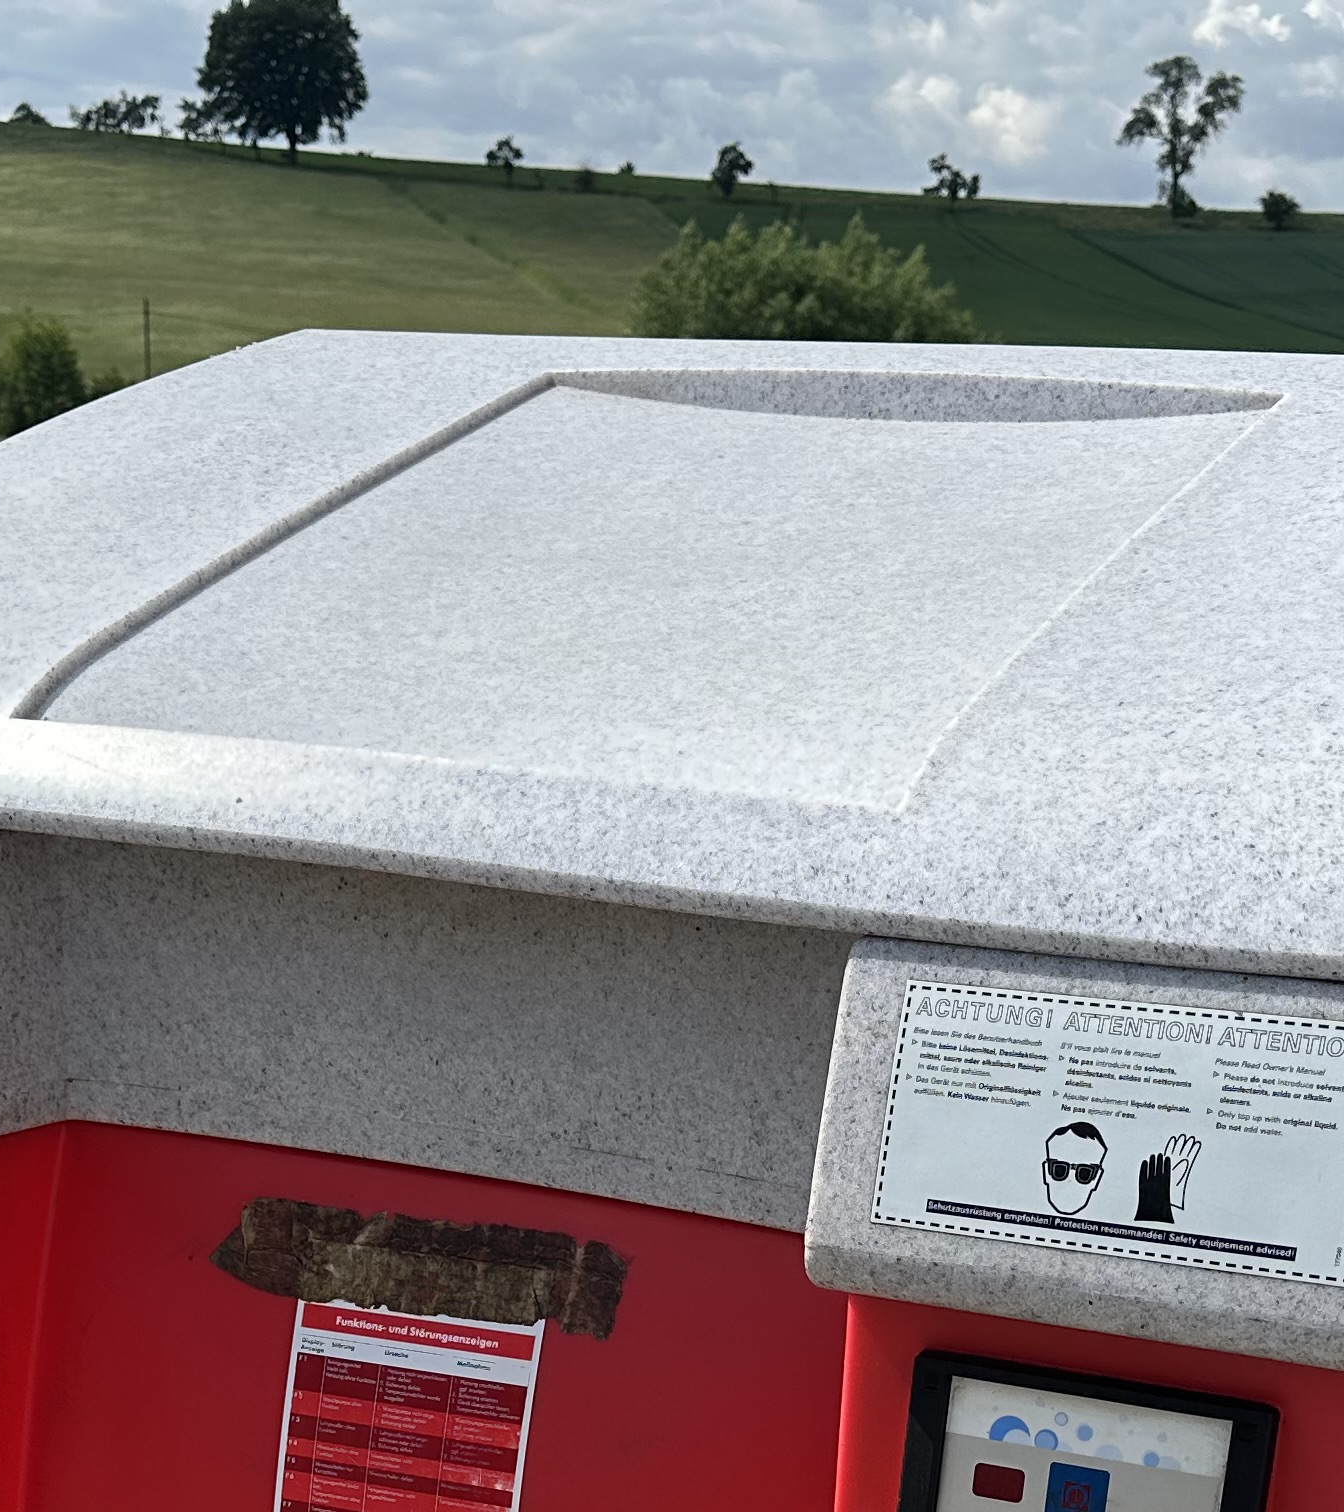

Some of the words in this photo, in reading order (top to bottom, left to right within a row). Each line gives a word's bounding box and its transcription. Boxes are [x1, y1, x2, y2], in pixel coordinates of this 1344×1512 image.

[915, 995, 1053, 1028] ACHTUNG!
[950, 1030, 962, 1038] Sie
[963, 1032, 976, 1040] das
[1062, 1010, 1213, 1044] ATTENTION!
[1074, 1044, 1091, 1052] vous
[1132, 1049, 1161, 1059] manuel
[1080, 1058, 1094, 1067] pas
[1132, 1063, 1142, 1071] de
[1214, 1057, 1239, 1067] Please
[1240, 1060, 1261, 1069] Read
[1262, 1062, 1294, 1073] Owner's
[1295, 1066, 1325, 1076] Manual
[915, 1075, 929, 1083] Das
[1223, 1072, 1248, 1082] Please
[1249, 1075, 1260, 1083] do
[1261, 1077, 1276, 1085] not
[1277, 1078, 1314, 1089] introduce
[947, 1091, 963, 1099] Kein
[963, 1093, 989, 1102] Wasser
[1072, 1106, 1086, 1114] pas
[1215, 1121, 1226, 1130] Do
[1228, 1123, 1242, 1131] not
[1243, 1124, 1258, 1133] add
[1217, 1109, 1236, 1120] Only
[1237, 1112, 1250, 1121] top
[1251, 1115, 1262, 1123] up
[1263, 1114, 1281, 1123] with
[1282, 1116, 1312, 1128] original
[1313, 1120, 1338, 1131] liquid.
[1053, 1217, 1099, 1232] Protection
[1167, 1233, 1197, 1246] Safety
[1198, 1237, 1254, 1253] equipement
[1255, 1244, 1295, 1258] advised!
[336, 1316, 387, 1334] Funktions-
[388, 1323, 408, 1336] und
[409, 1325, 499, 1349] Störungsanzeigen
